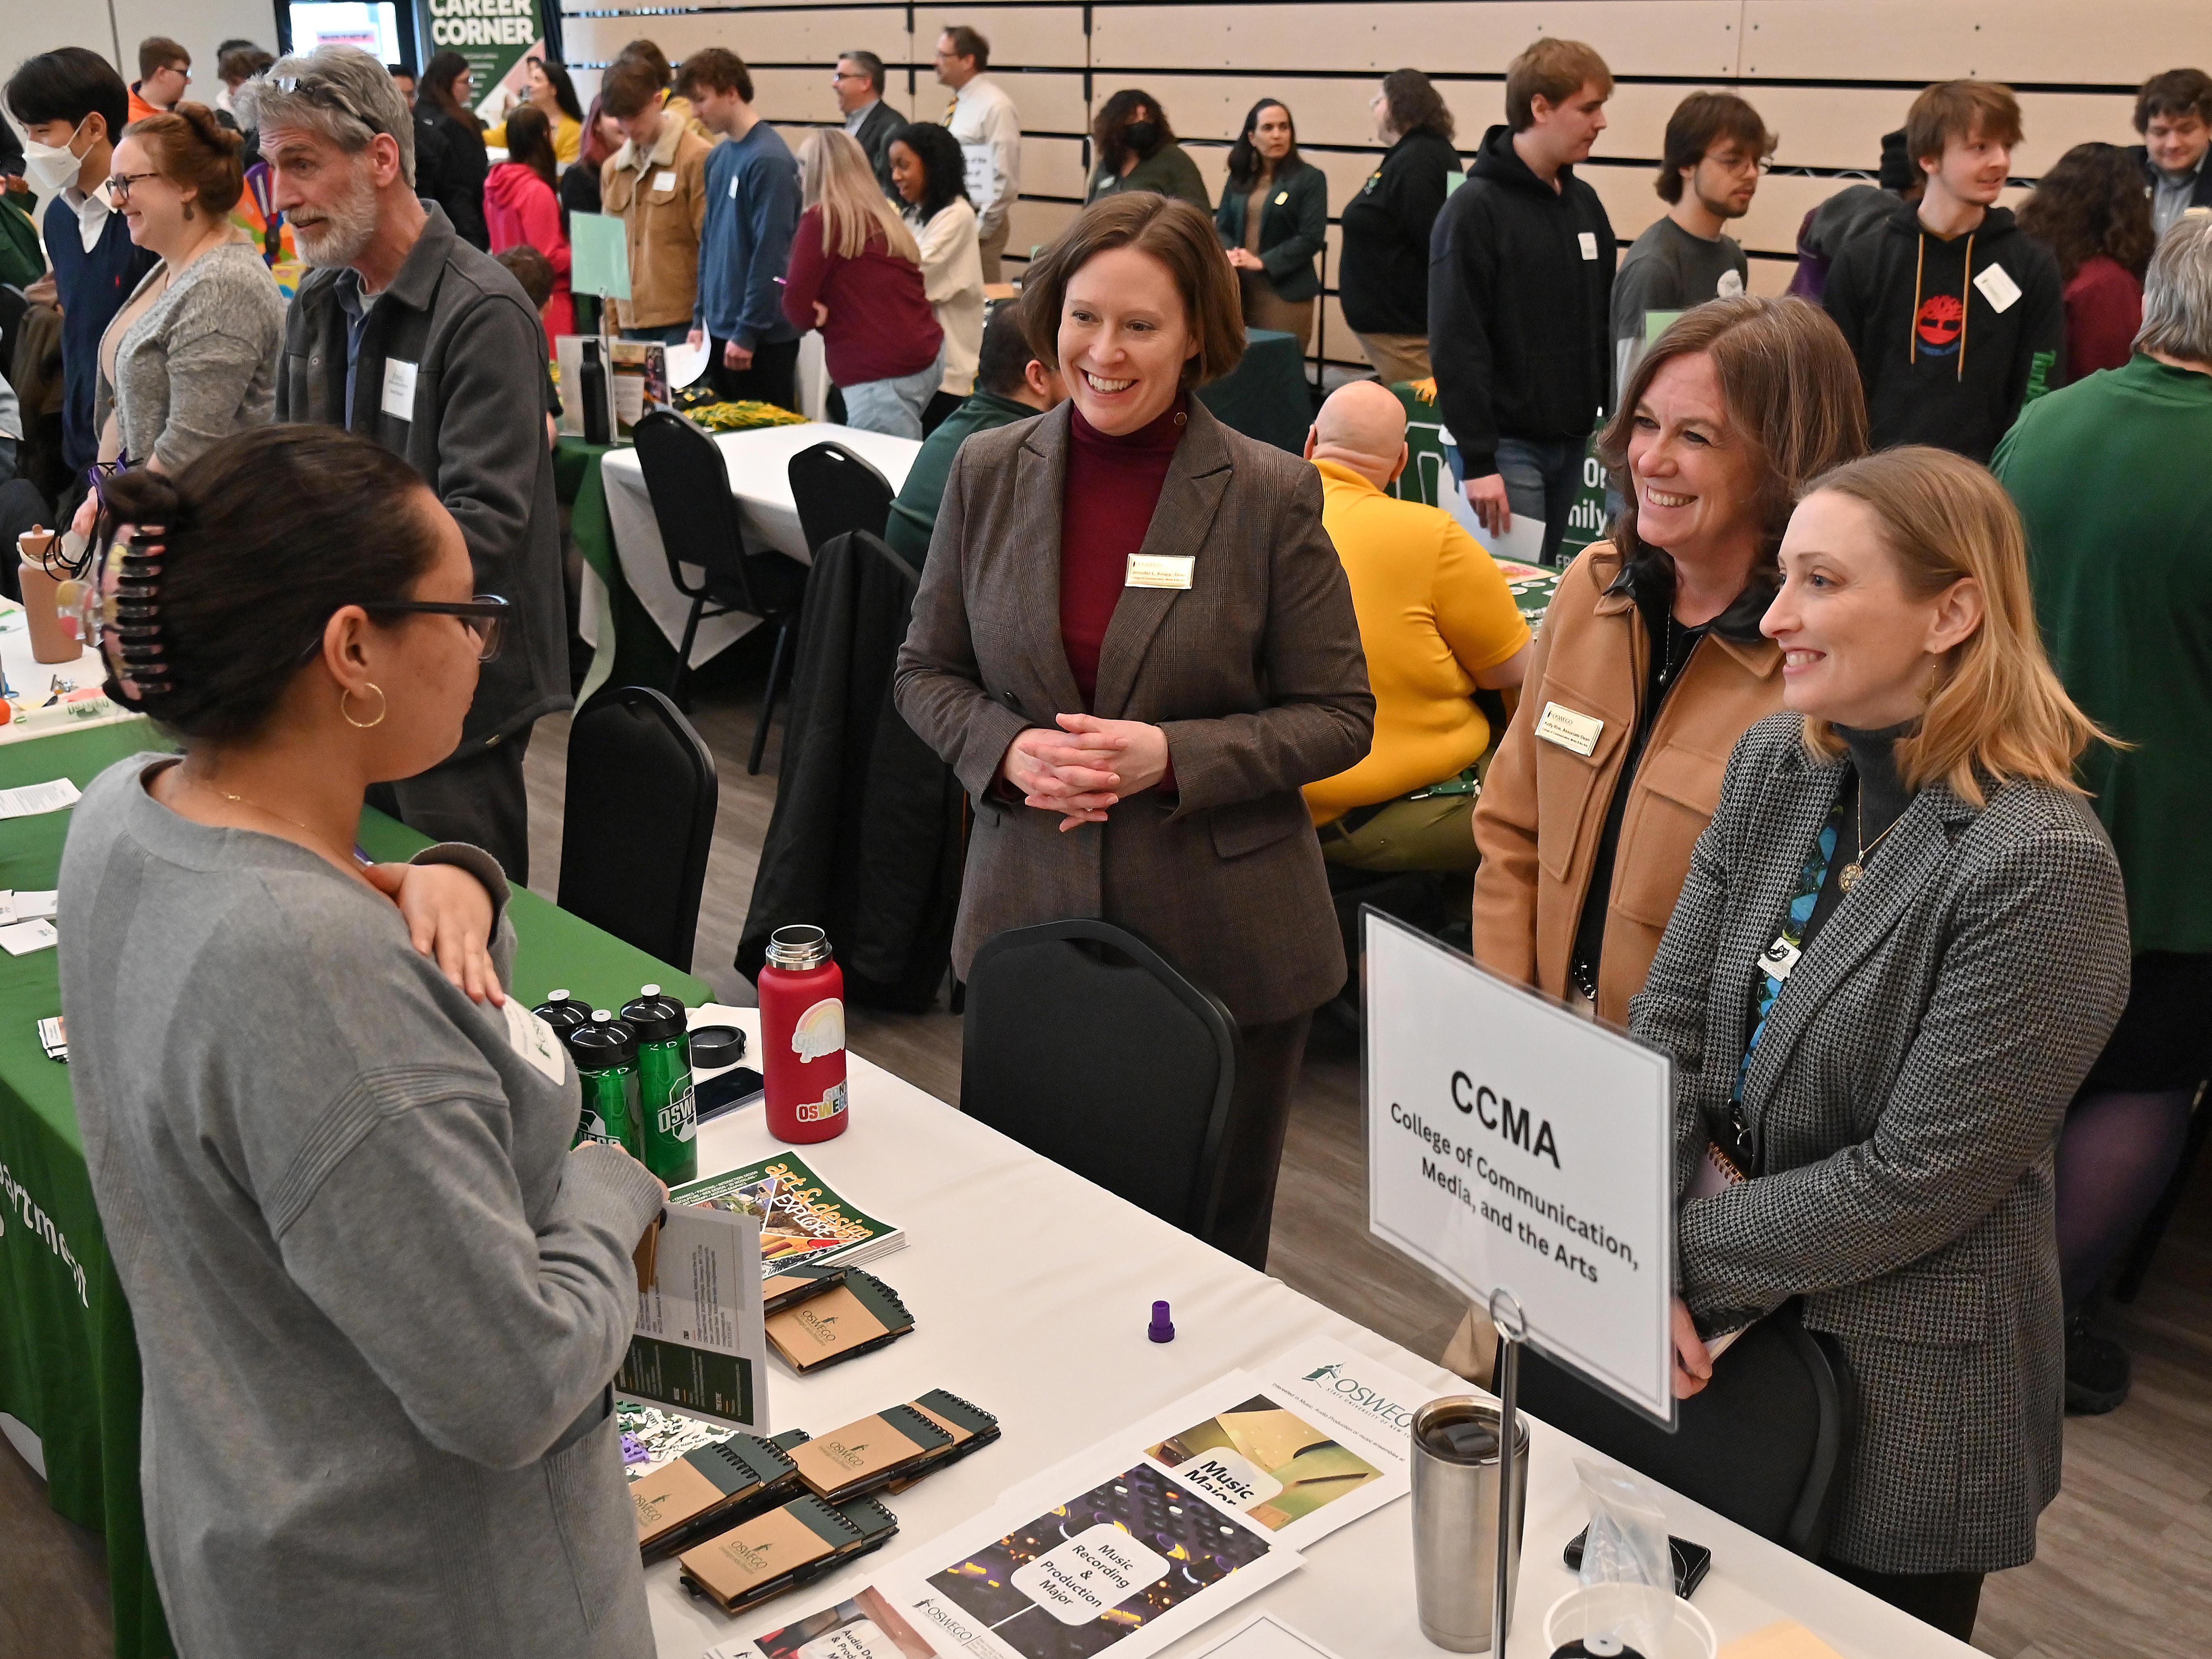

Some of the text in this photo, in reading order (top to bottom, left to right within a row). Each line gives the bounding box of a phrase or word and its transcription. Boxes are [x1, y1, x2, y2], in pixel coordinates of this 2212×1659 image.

[432, 17, 535, 45] CORNER
[1552, 714, 1573, 724] OSWEGO
[1562, 728, 1580, 737] Associate
[1451, 1070, 1561, 1170] CCMA
[674, 1191, 694, 1201] CERAMICS
[697, 1184, 716, 1194] PAINTING
[718, 1175, 743, 1187] INTERACTION
[711, 1188, 727, 1196] MOTION
[728, 1181, 747, 1191] GRAPHICS
[765, 1163, 874, 1239] art & design
[1391, 1102, 1639, 1271] College of Communication,
[1422, 1156, 1598, 1283] Media, and the Arts
[803, 1310, 836, 1341] OSWEGO
[1326, 1388, 1343, 1399] STATE
[1344, 1398, 1379, 1420] UNIVERSITY
[1388, 1424, 1403, 1434] NEW
[1335, 1379, 1413, 1428] OSWEG
[1272, 1382, 1295, 1397] Interested
[1314, 1408, 1328, 1417] Audio
[1327, 1415, 1353, 1432] Production
[1358, 1434, 1373, 1443] music
[1373, 1441, 1399, 1458] ensembles
[829, 1441, 864, 1466] OSWEGO
[1199, 1460, 1255, 1499] Music
[632, 1494, 662, 1521] OSWEGO
[731, 1541, 768, 1568] OSWEGO
[1072, 1544, 1130, 1589] Recording
[1098, 1544, 1134, 1571] Music
[1040, 1560, 1102, 1607] Production
[1080, 1570, 1093, 1580] &
[1039, 1579, 1073, 1605] Major
[927, 1607, 972, 1640] OSWEGO
[842, 1630, 863, 1650] Audio
